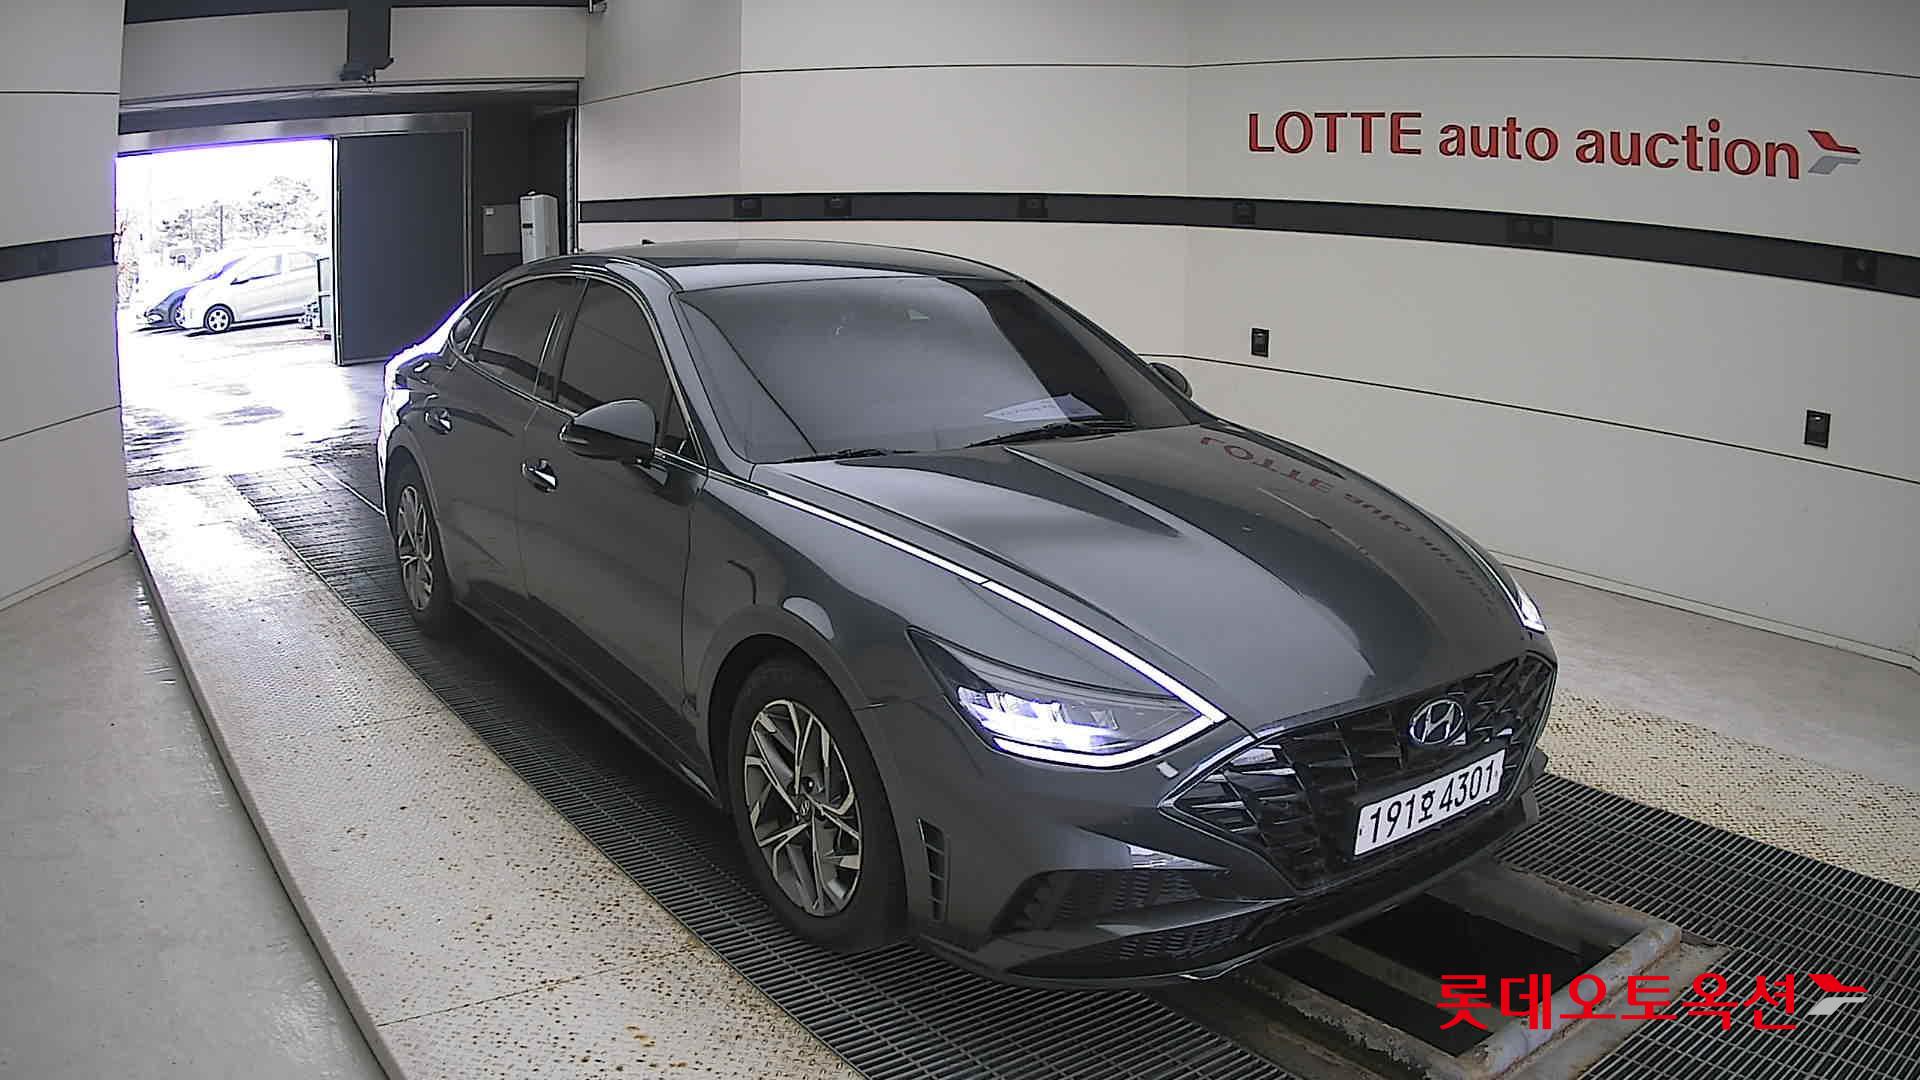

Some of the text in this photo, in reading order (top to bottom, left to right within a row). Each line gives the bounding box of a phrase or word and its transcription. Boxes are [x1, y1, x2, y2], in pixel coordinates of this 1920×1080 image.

[1248, 111, 1801, 179] LOTTE auto auction
